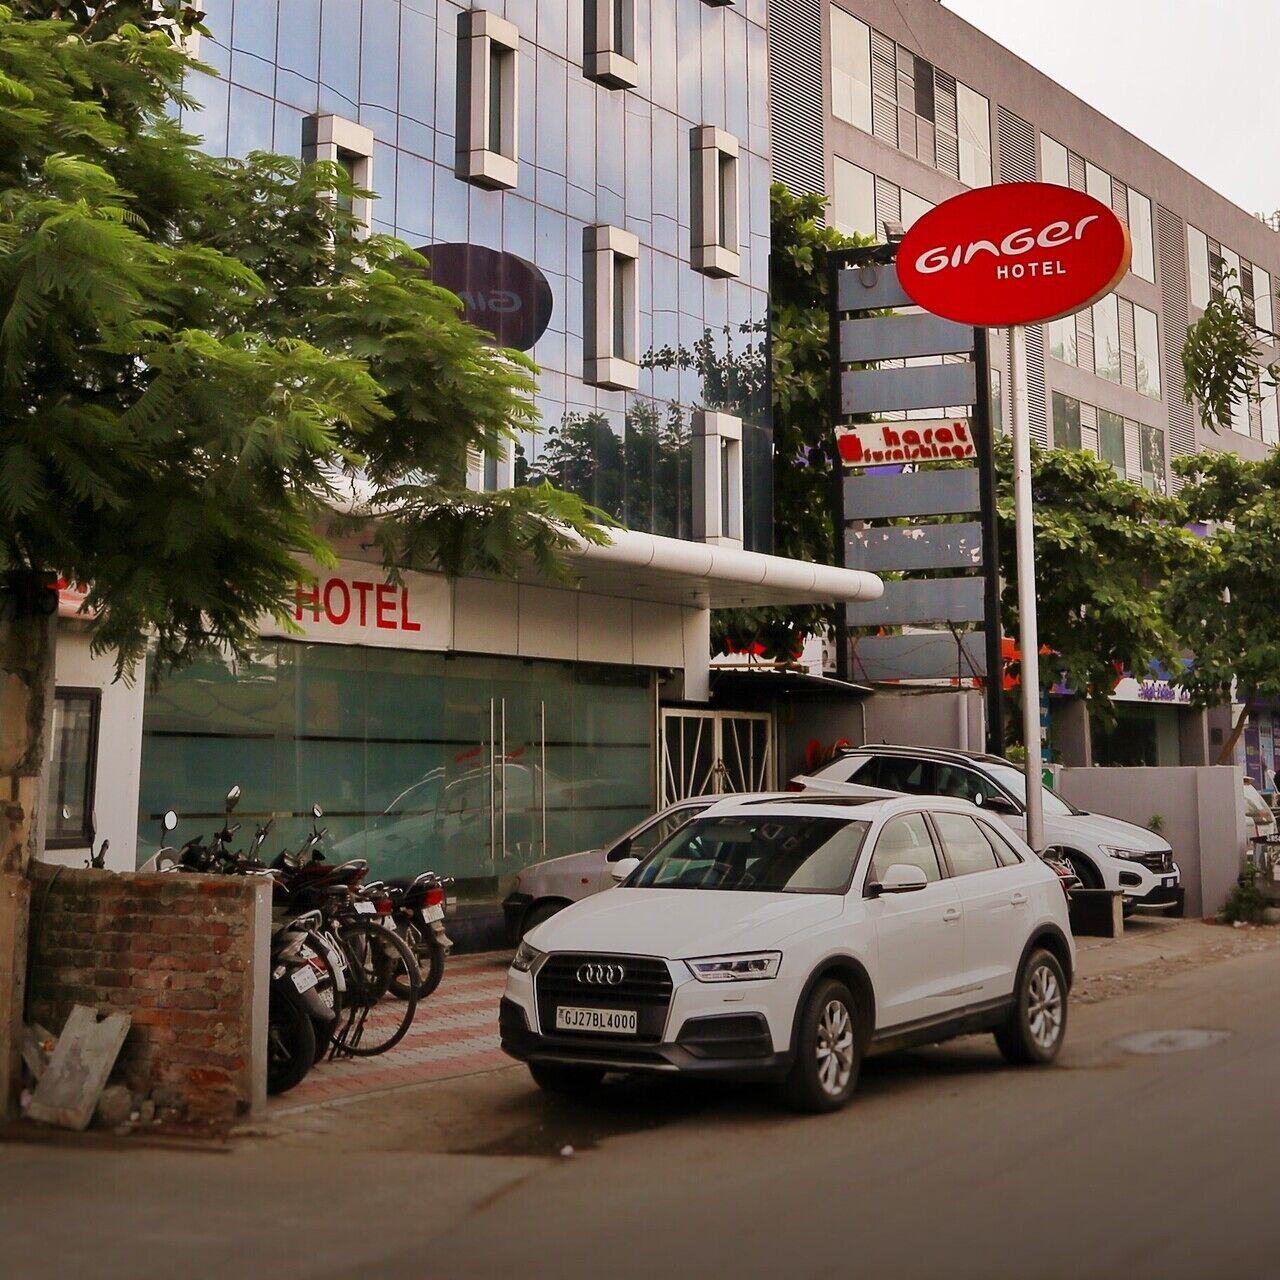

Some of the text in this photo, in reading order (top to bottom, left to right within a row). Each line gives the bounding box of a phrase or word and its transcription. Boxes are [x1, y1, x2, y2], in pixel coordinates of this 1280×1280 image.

[996, 260, 1066, 280] HOTEL
[295, 577, 421, 631] HOTEL
[565, 1010, 636, 1029] GJ27BL4000
